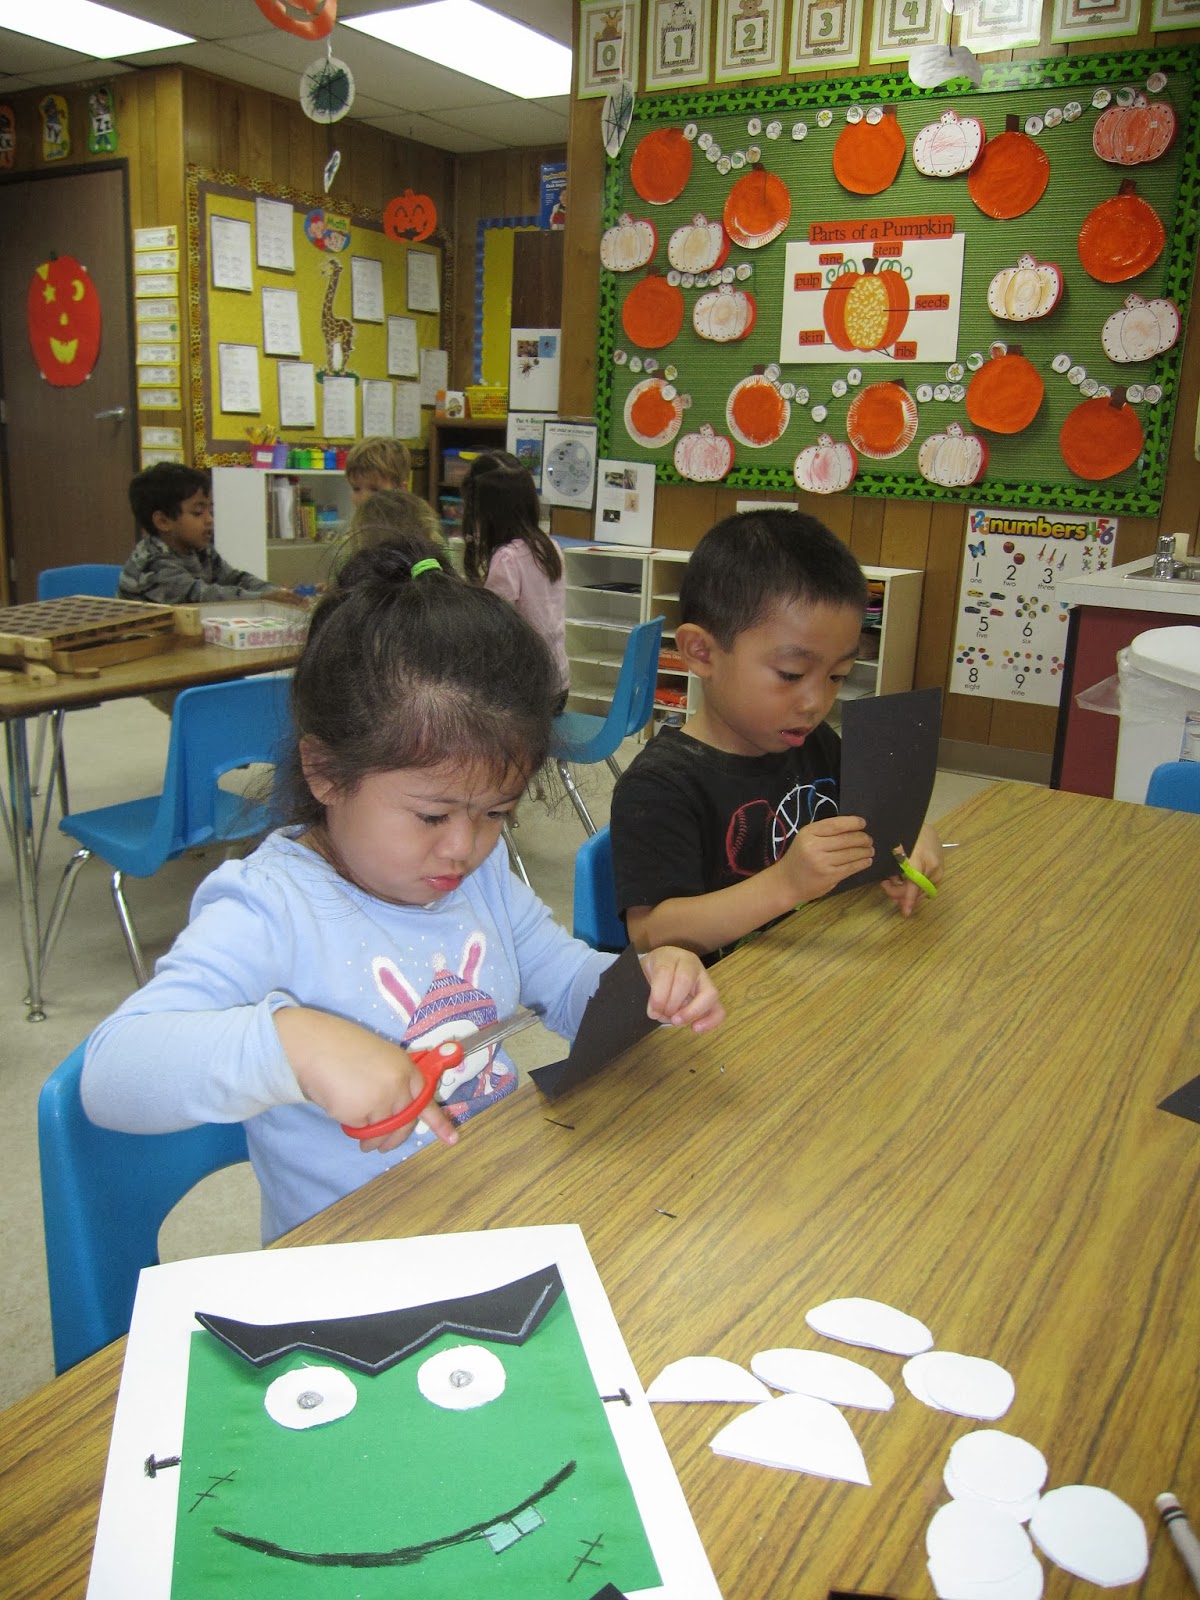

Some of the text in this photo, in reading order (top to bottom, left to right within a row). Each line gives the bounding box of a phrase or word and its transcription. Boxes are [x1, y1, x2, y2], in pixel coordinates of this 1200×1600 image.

[902, 1, 919, 25] 4
[818, 12, 833, 37] 3
[743, 23, 757, 47] 2
[898, 36, 919, 46] four
[673, 34, 683, 57] 1
[812, 47, 836, 56] three
[602, 44, 616, 67] 0
[812, 220, 953, 242] Parts of a Pumpkin
[873, 244, 901, 256] stem
[819, 255, 842, 265] vine
[795, 275, 820, 288] pulp
[916, 296, 948, 309] seeds
[800, 332, 823, 343] skin
[895, 343, 916, 356] ribs
[990, 516, 1088, 541] numbers
[975, 562, 1053, 584] 1 2 3
[1037, 583, 1055, 591] three
[978, 616, 1033, 637] 5 6
[976, 631, 988, 639] five
[968, 667, 1025, 689] 8 9
[964, 683, 1025, 697] eight nine
